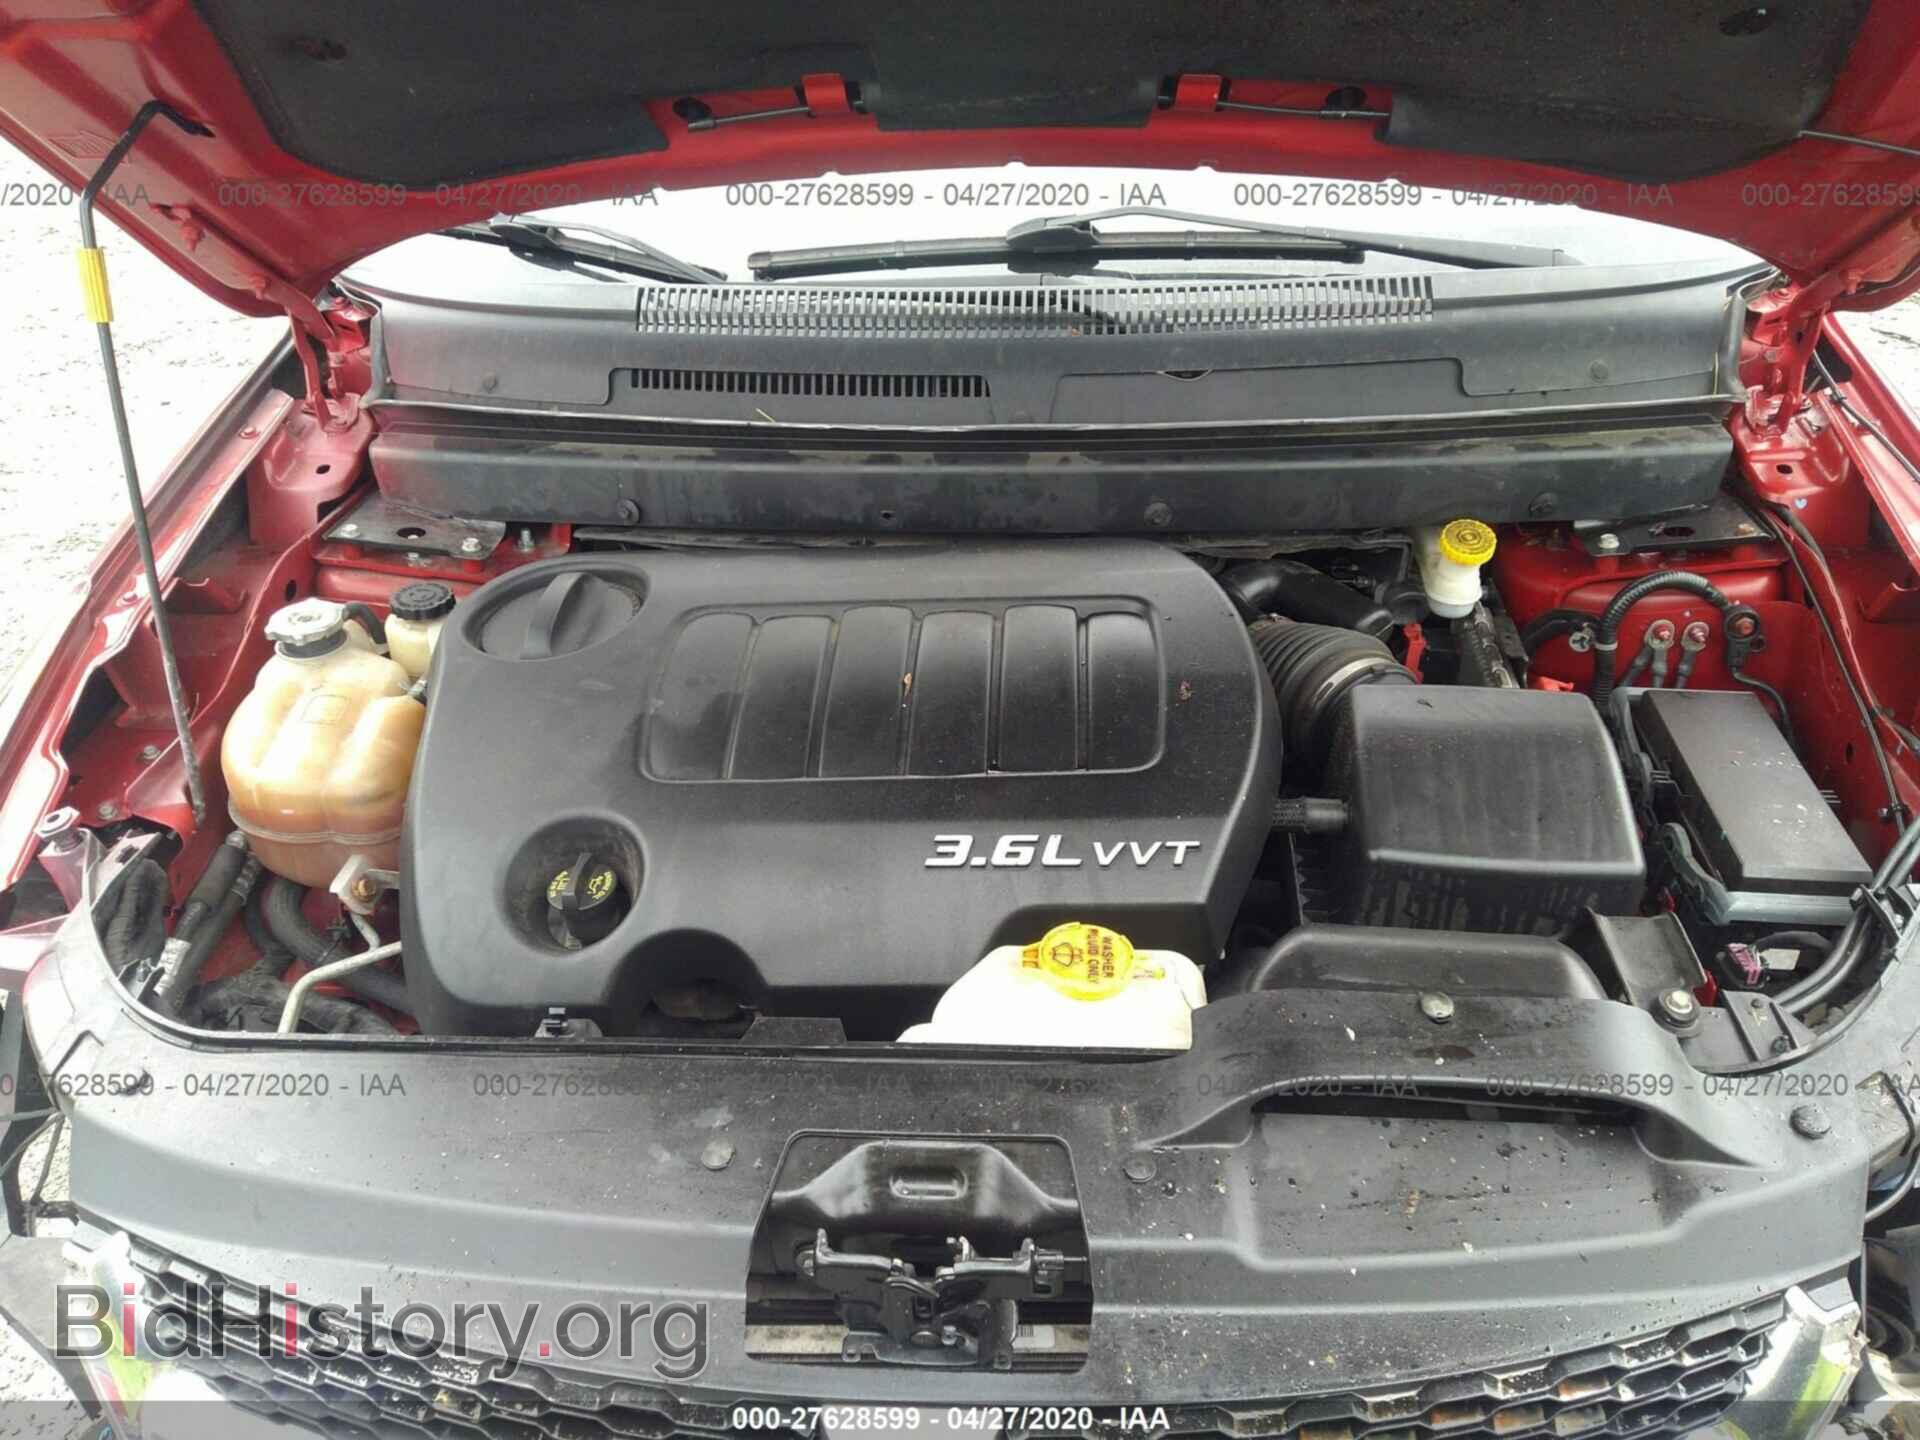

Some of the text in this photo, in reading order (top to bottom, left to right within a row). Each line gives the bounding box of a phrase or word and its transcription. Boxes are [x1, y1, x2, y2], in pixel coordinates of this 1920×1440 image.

[924, 834, 1200, 867] 3.6L VVT
[1102, 936, 1115, 978] WASHER
